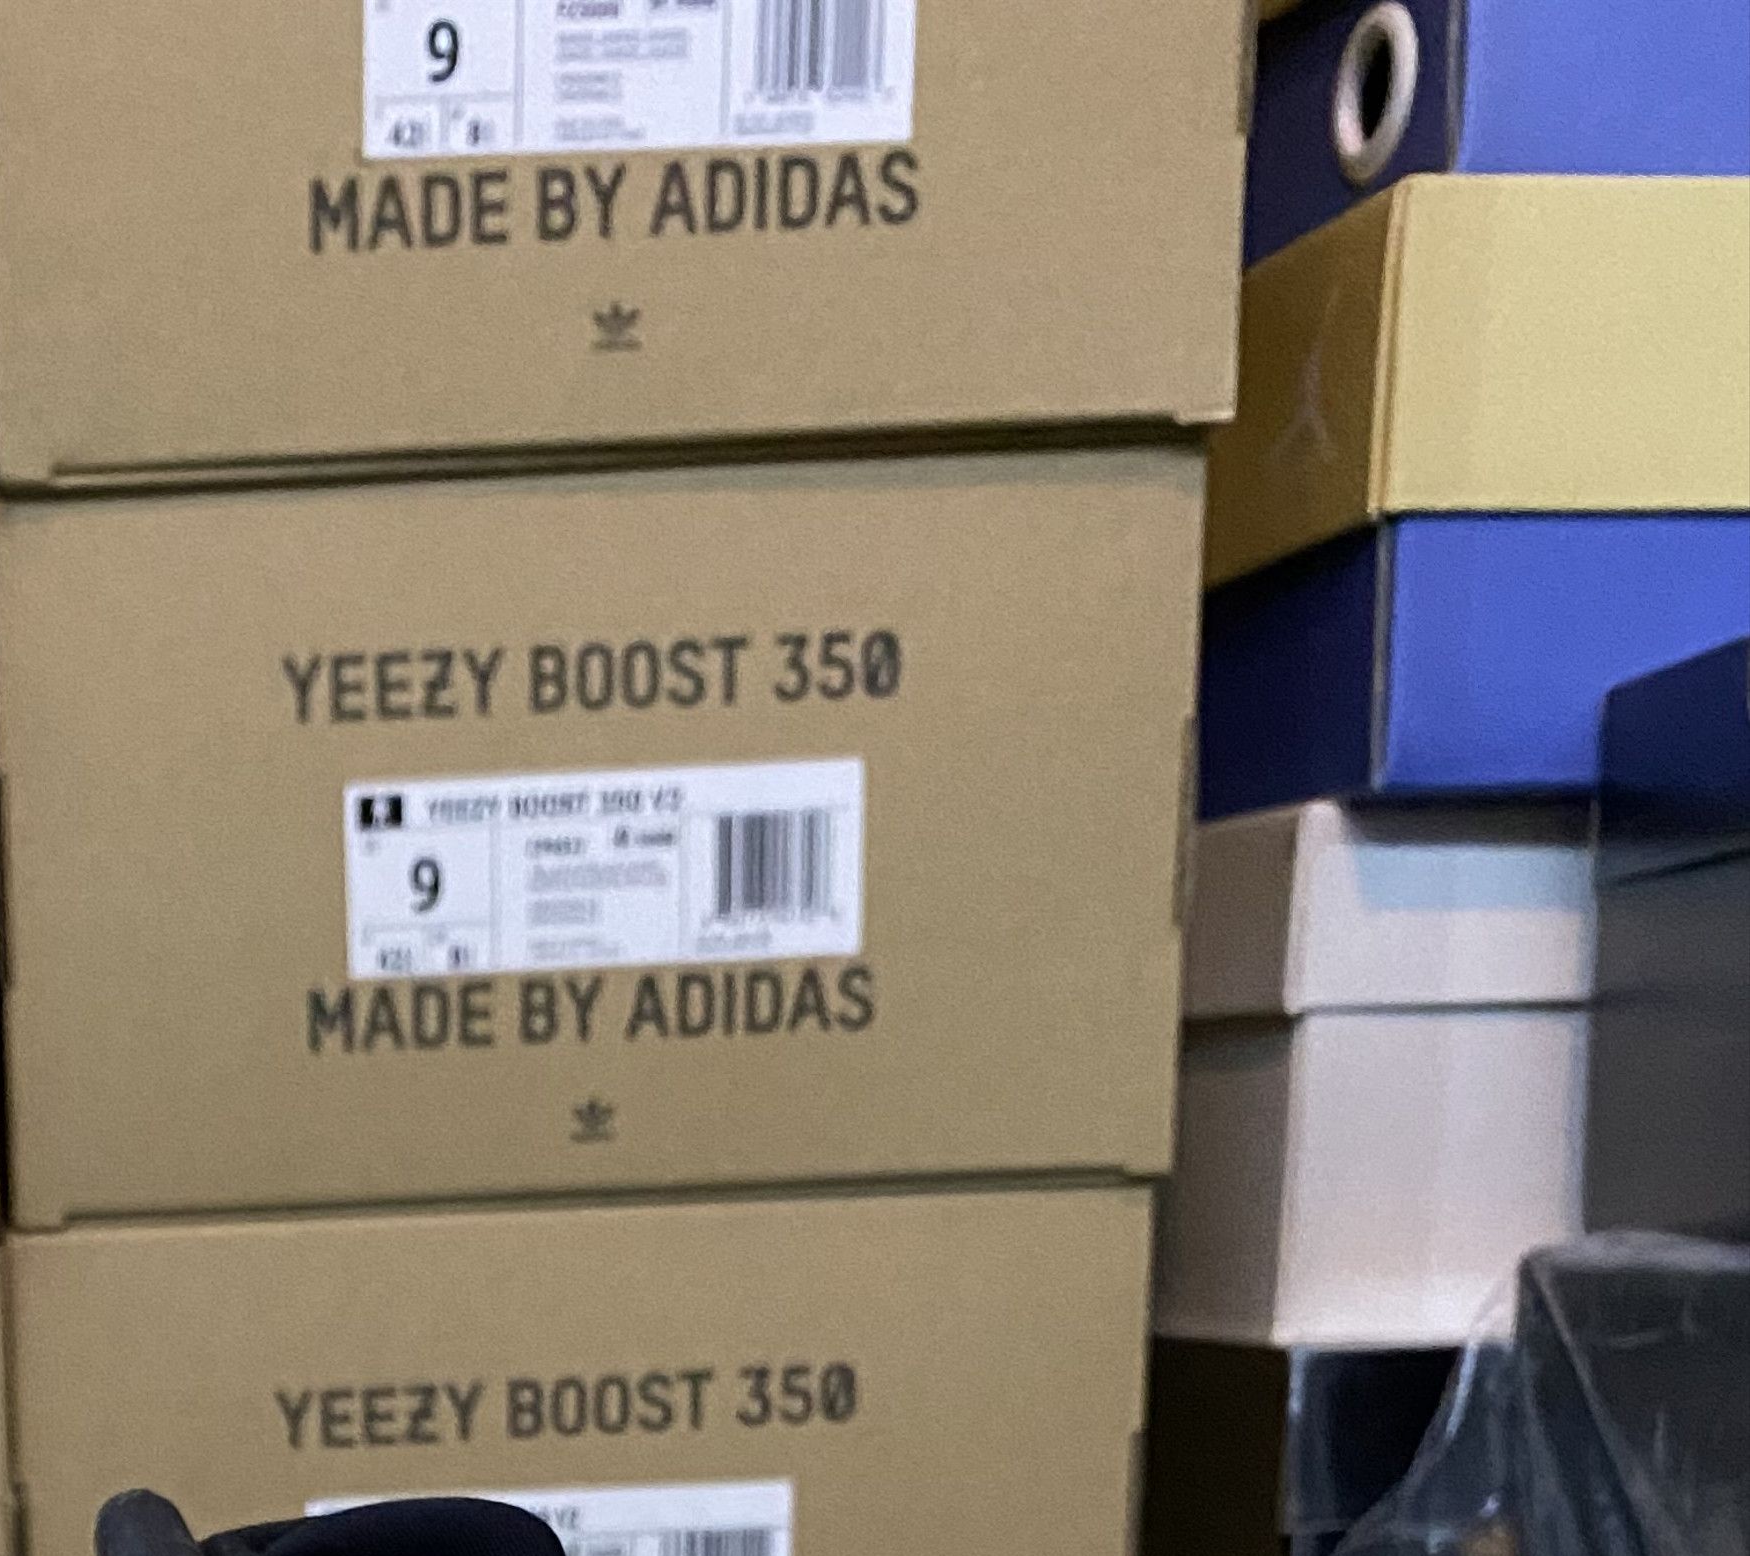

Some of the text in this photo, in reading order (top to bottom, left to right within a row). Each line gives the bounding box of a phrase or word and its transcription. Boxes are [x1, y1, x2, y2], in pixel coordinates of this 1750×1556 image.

[425, 18, 462, 85] 9
[307, 147, 922, 256] MADE BY ADIDAS
[280, 627, 904, 726] YEEZY BOOST 350
[408, 856, 444, 915] 9
[305, 962, 877, 1055] MADE BY ADIDAS
[272, 1359, 860, 1451] YEEZY BOOST 350
